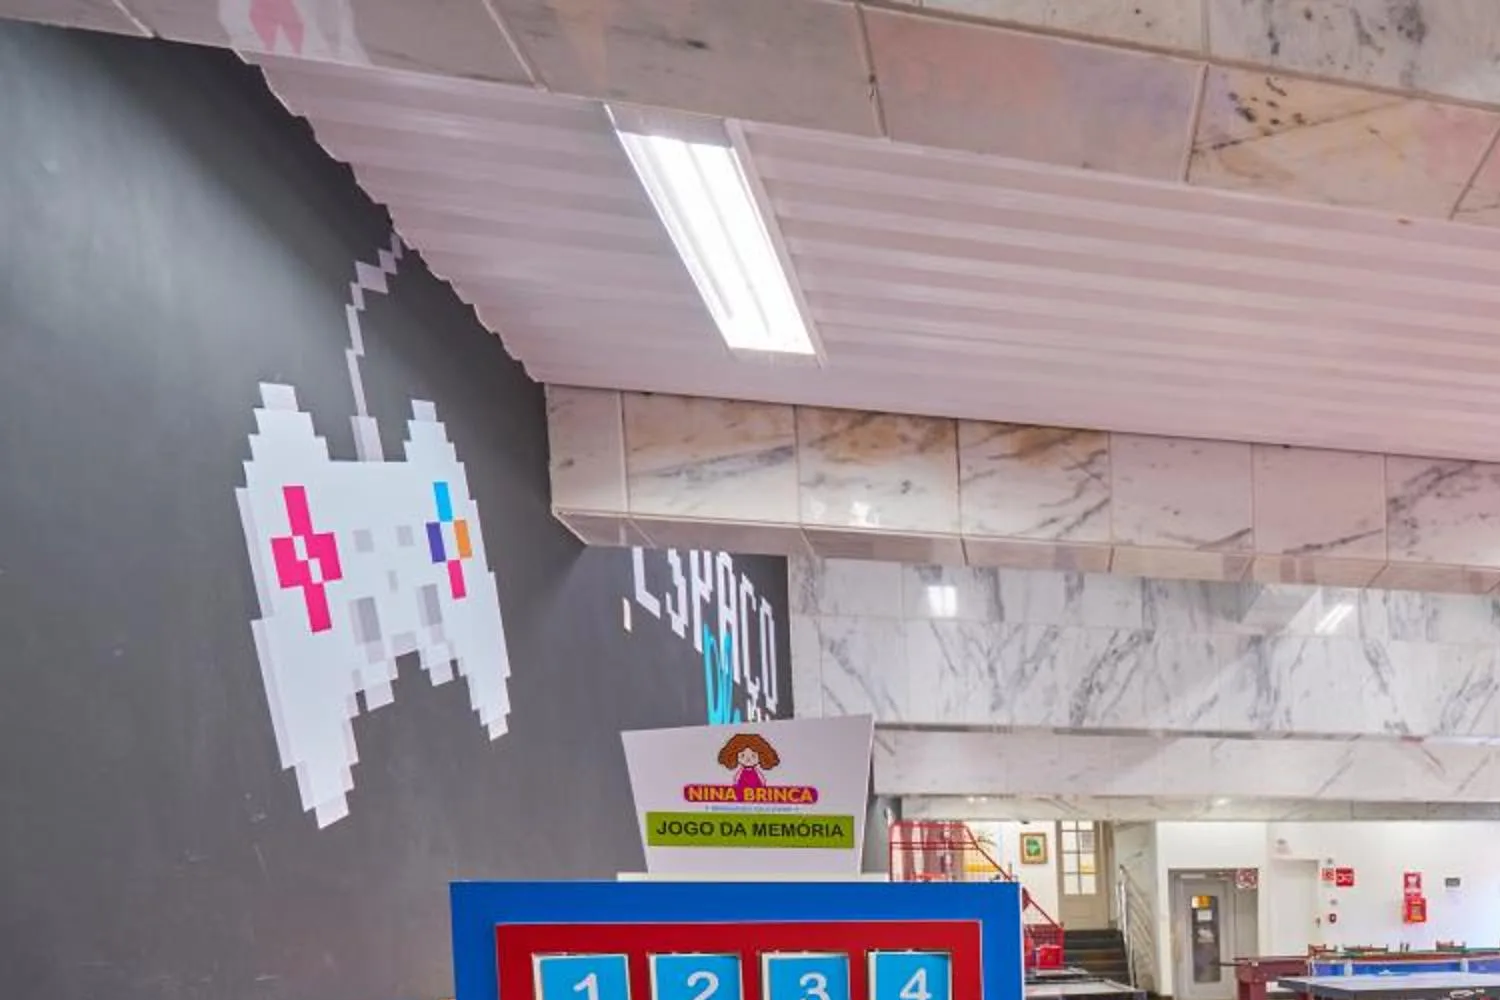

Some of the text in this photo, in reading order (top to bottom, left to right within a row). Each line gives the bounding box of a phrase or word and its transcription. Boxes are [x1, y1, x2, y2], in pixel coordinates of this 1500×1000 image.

[687, 787, 813, 803] NINA BRINCA
[656, 817, 844, 838] JOGO DA MEMÓRIA
